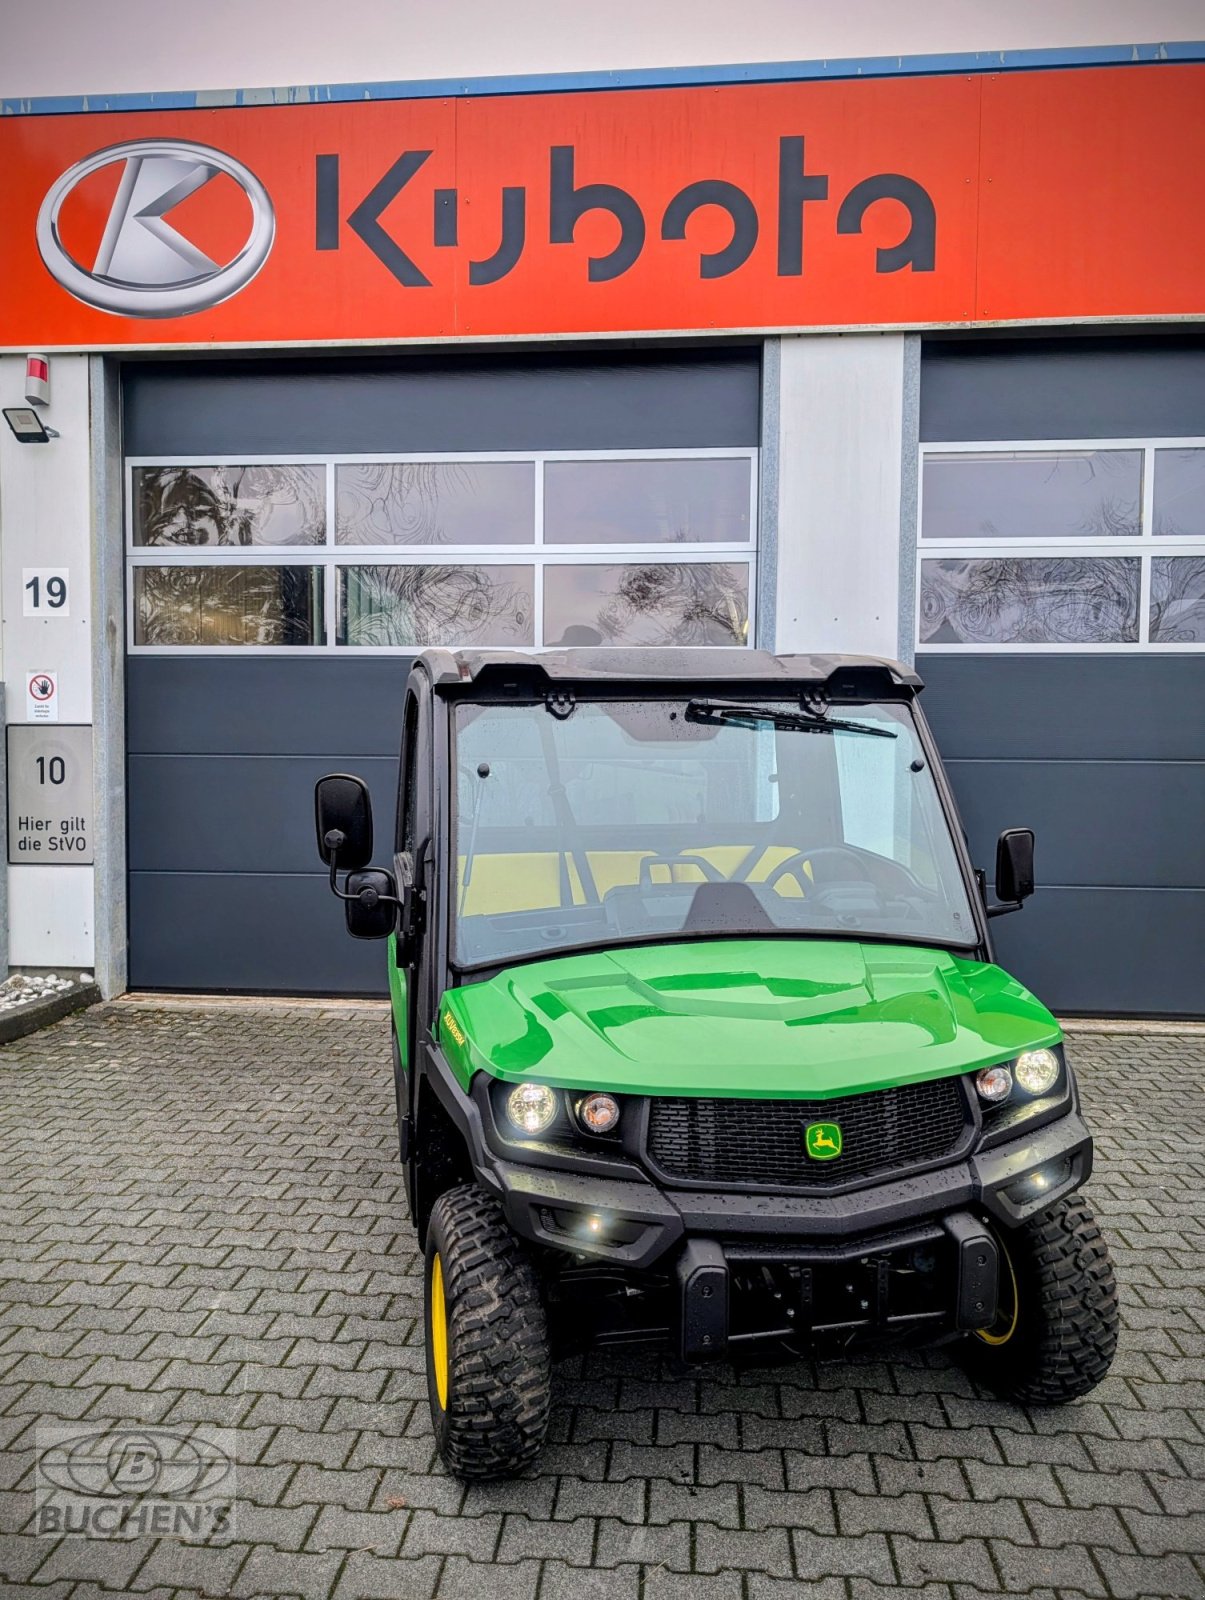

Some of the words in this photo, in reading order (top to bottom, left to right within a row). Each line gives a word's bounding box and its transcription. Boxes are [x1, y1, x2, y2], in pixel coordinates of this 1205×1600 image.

[315, 135, 937, 288] Kubota
[25, 576, 67, 608] 19
[36, 756, 66, 785] 10
[18, 816, 52, 831] Hier
[60, 816, 86, 835] gilt
[18, 836, 42, 851] die
[48, 836, 87, 851] StVO
